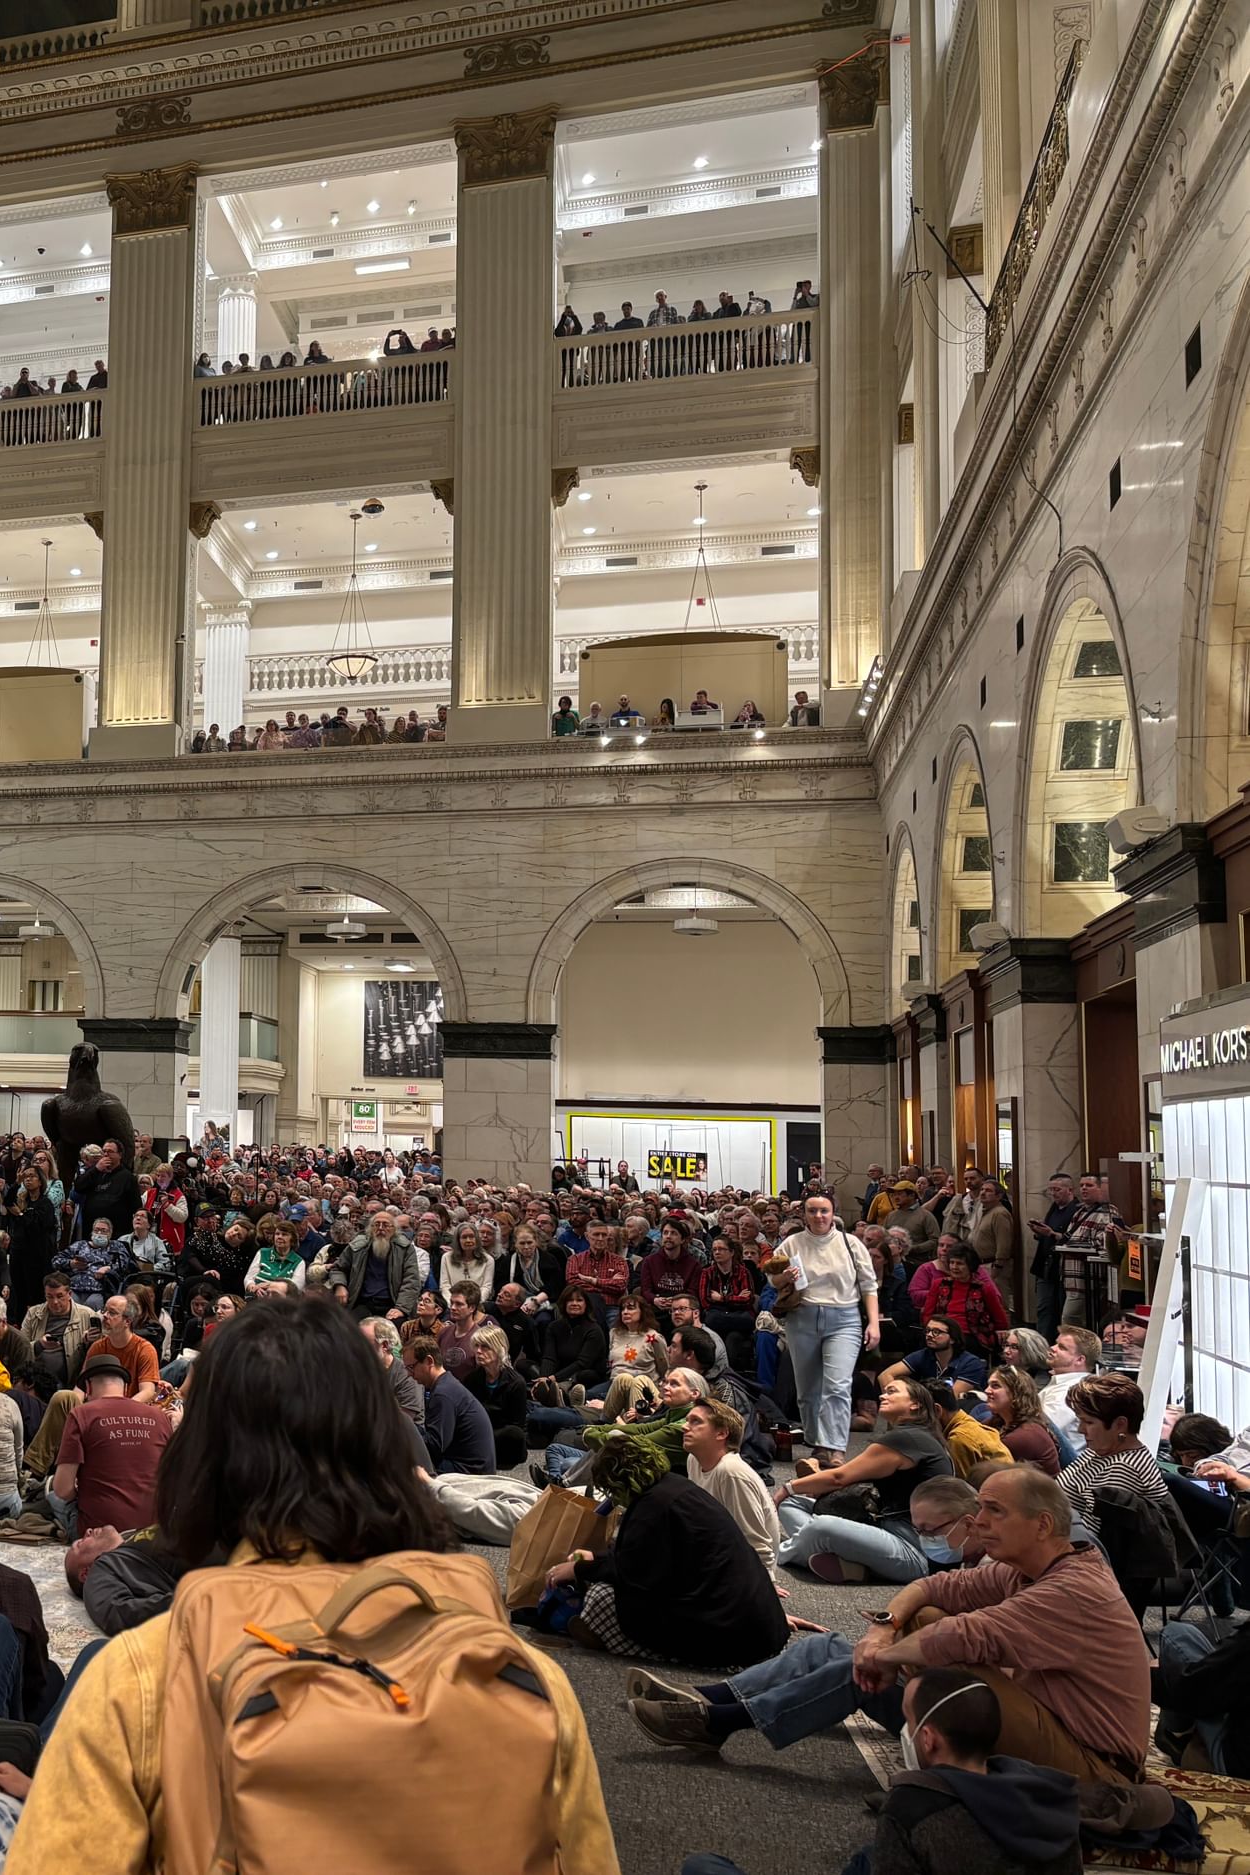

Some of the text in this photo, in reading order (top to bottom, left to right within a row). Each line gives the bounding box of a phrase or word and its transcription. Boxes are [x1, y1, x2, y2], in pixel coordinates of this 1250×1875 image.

[1160, 1025, 1248, 1074] MICHAEL KORS
[649, 1155, 696, 1178] SALE
[100, 1416, 156, 1427] CULTURED
[110, 1429, 150, 1439] AS FUNK
